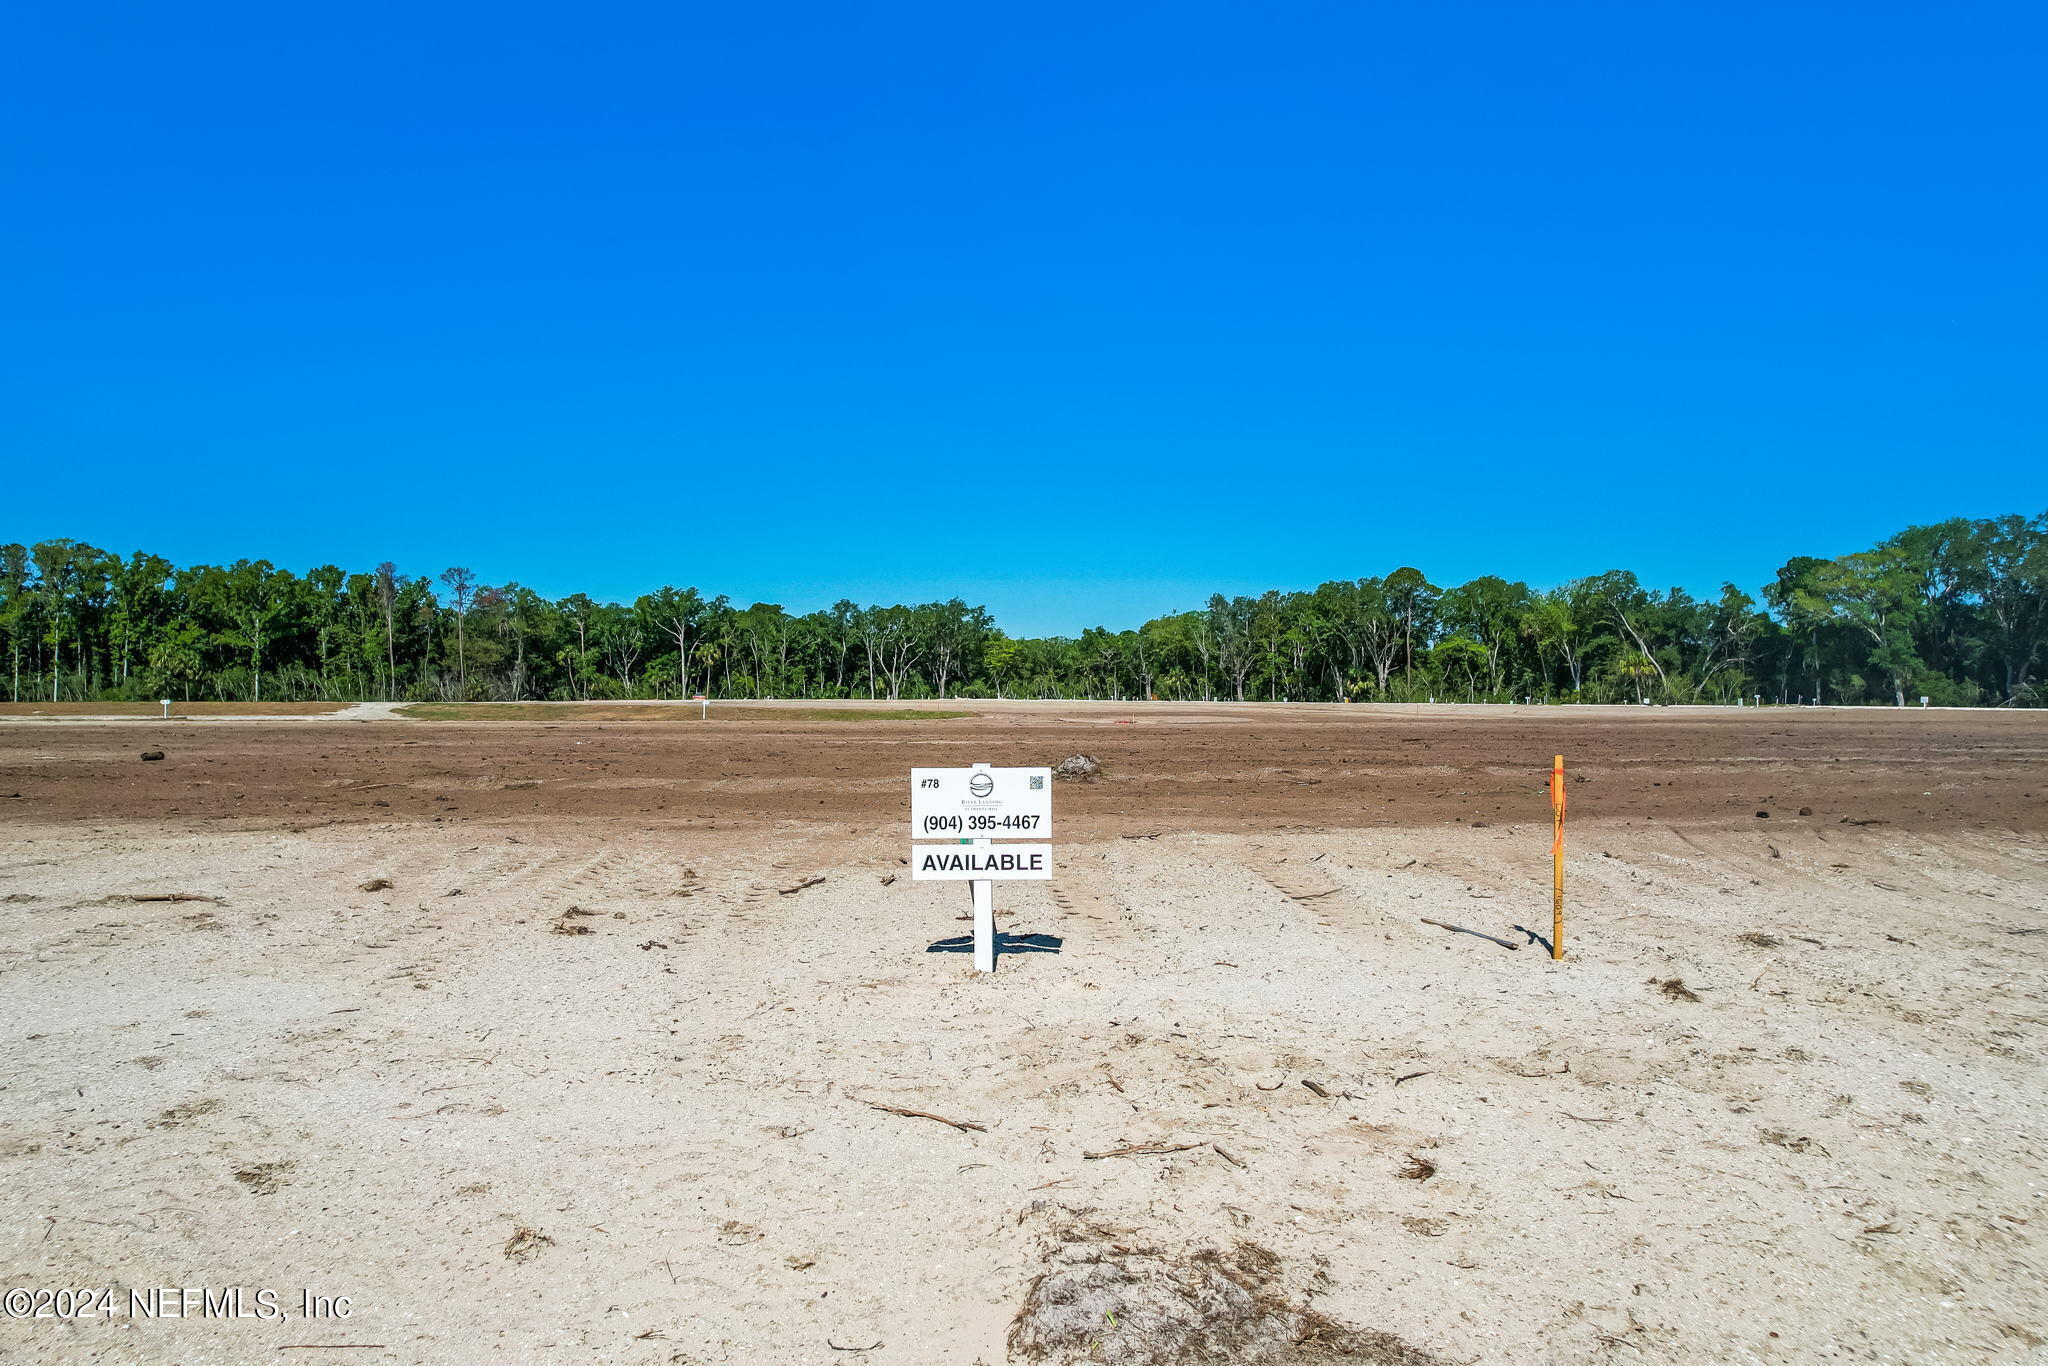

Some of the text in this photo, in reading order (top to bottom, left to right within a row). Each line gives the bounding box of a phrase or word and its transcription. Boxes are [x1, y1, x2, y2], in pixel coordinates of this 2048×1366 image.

[921, 779, 940, 789] #78
[923, 815, 1041, 833] (904) 395-4467
[922, 854, 1043, 871] AVAILABLE
